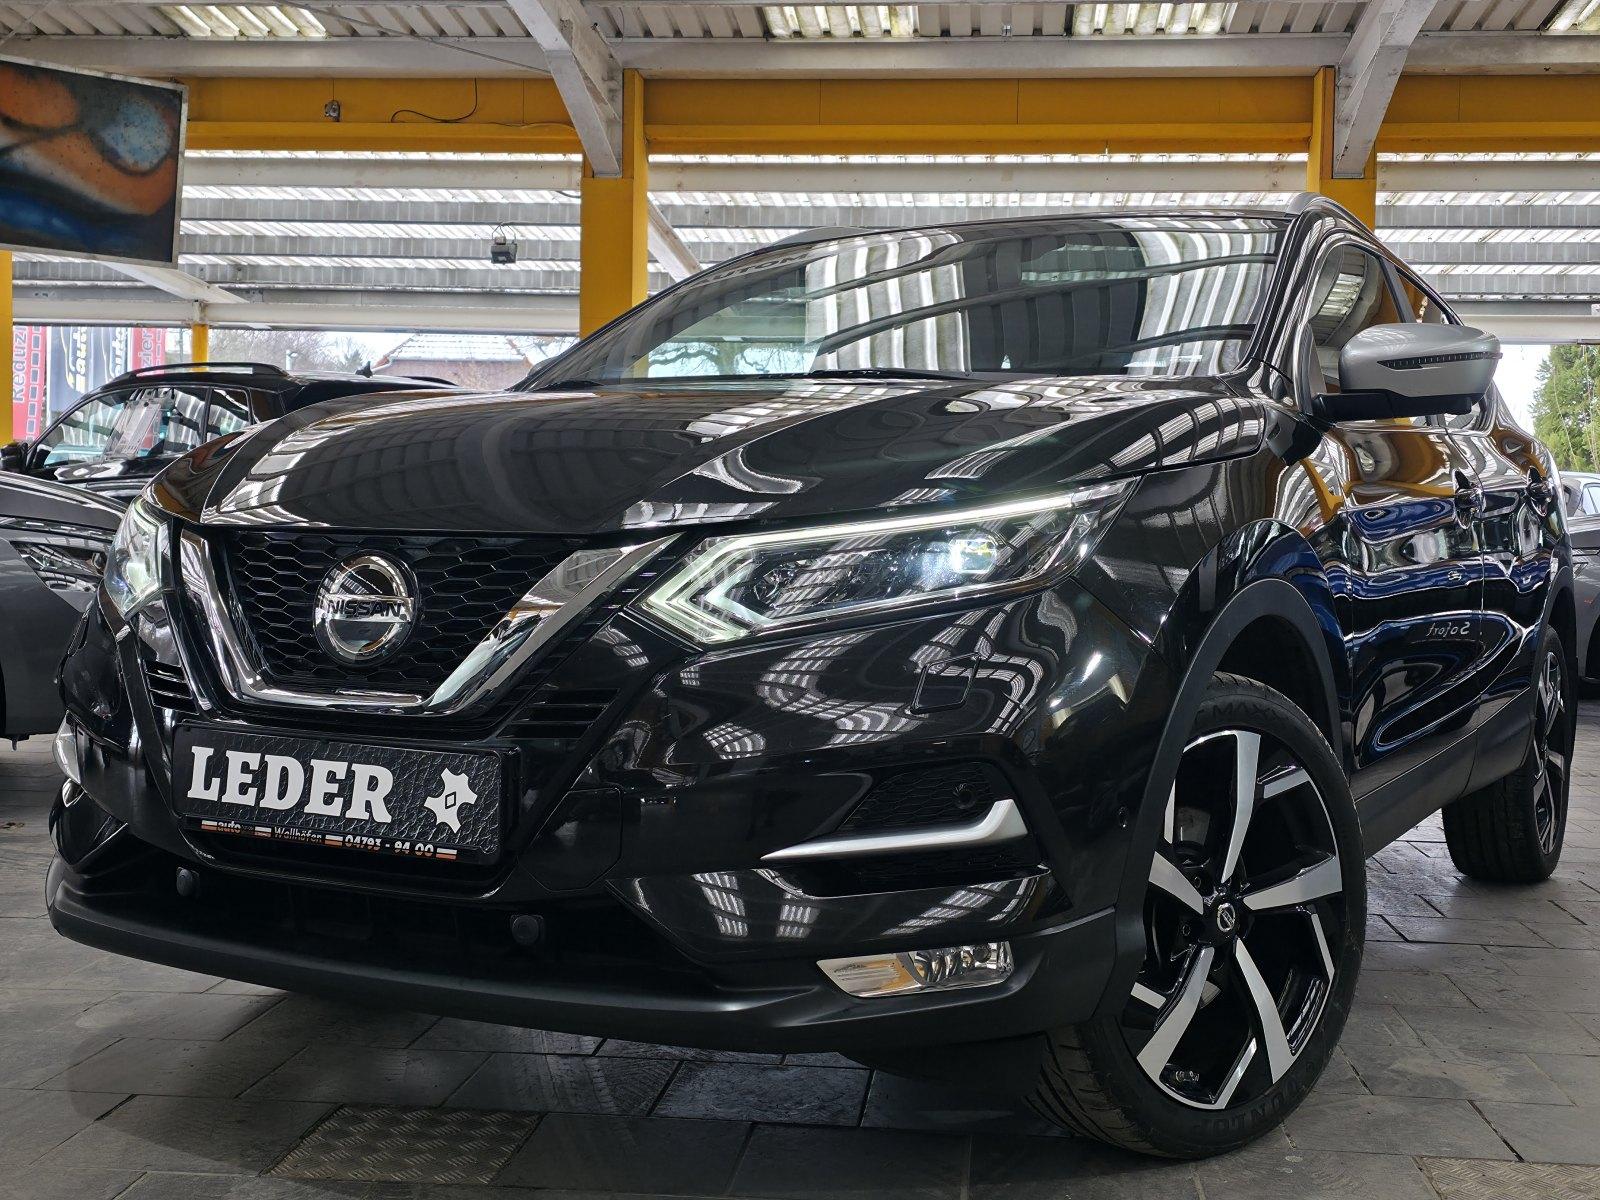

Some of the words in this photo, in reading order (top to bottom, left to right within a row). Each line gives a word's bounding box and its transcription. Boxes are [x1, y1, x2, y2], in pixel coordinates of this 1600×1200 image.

[323, 600, 402, 620] NISSAN
[187, 745, 392, 823] LEDER
[217, 820, 241, 834] auto
[344, 834, 381, 851] 04793
[414, 842, 434, 857] 00
